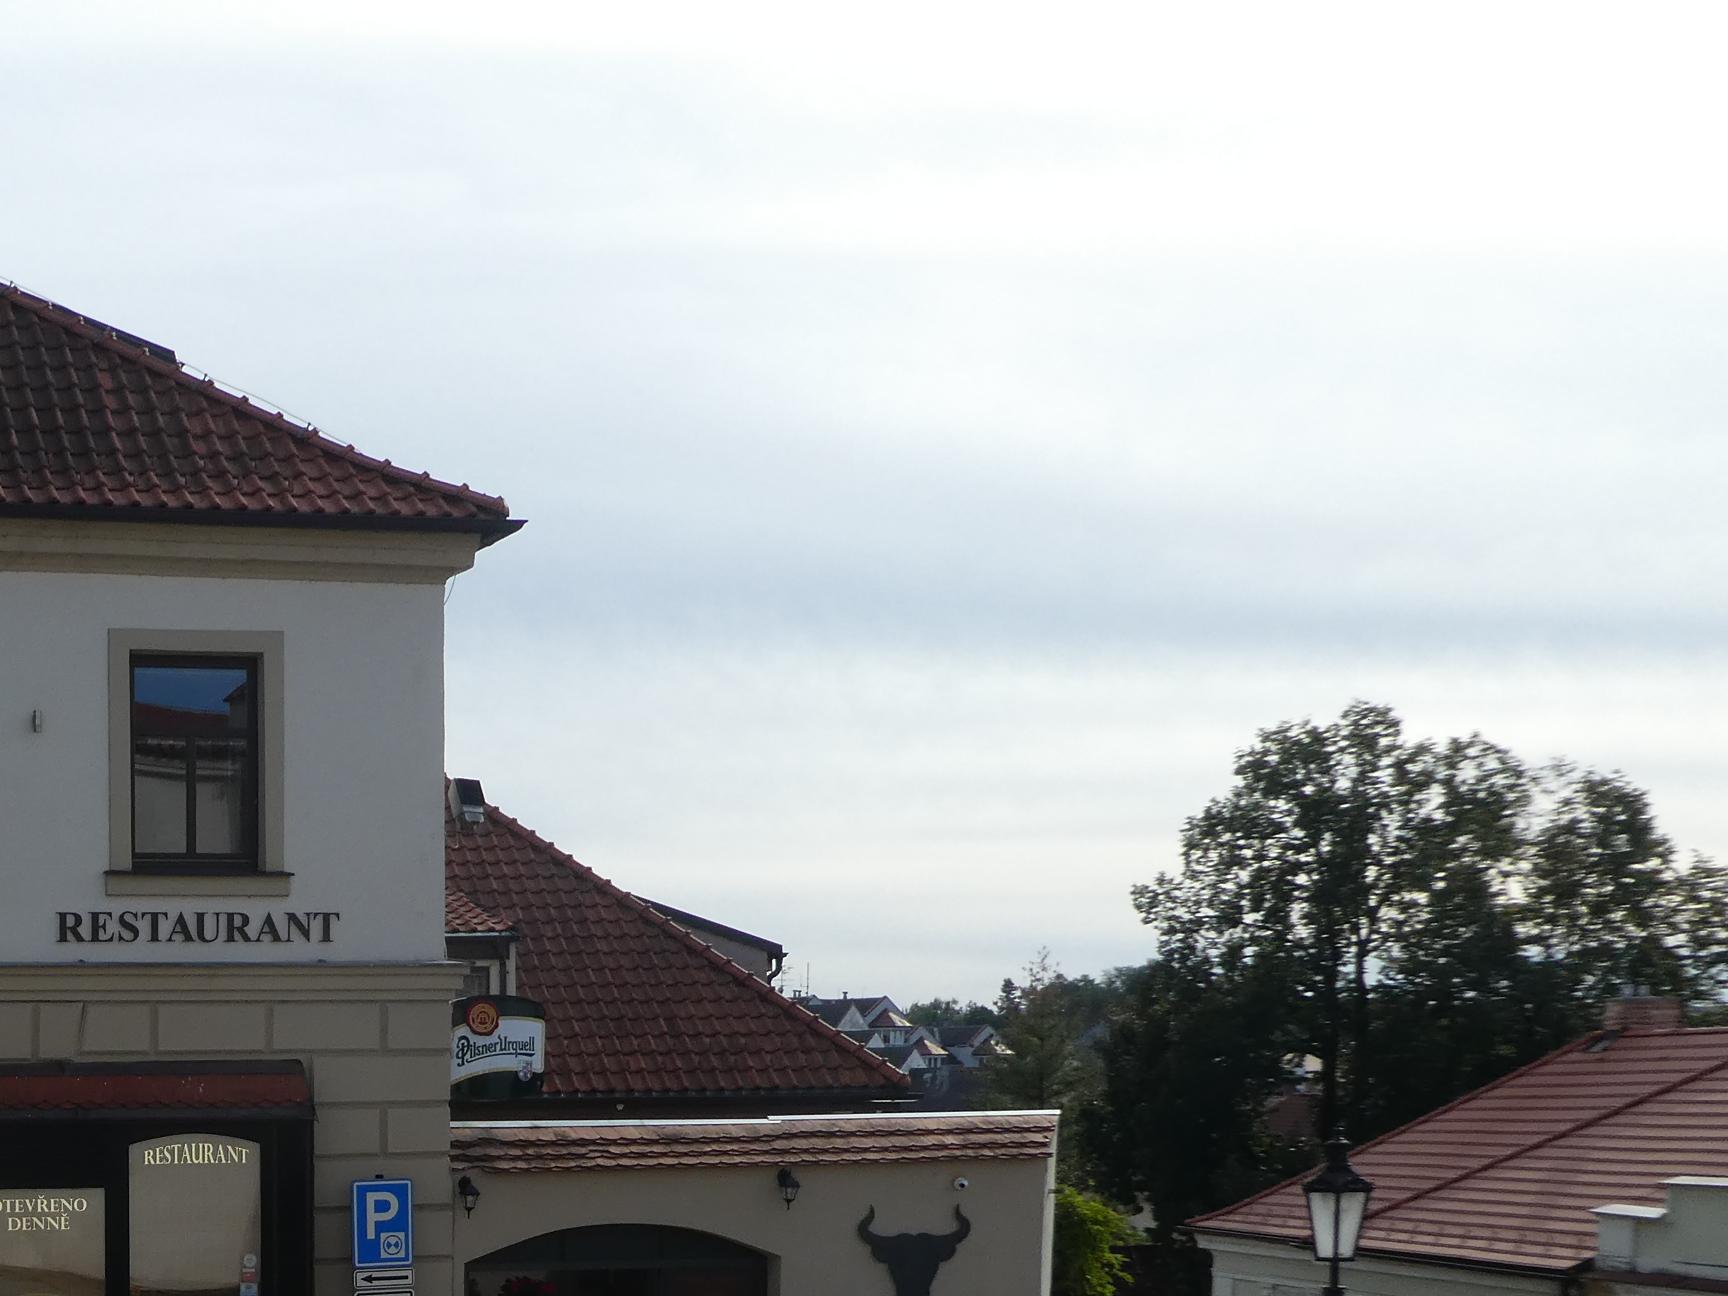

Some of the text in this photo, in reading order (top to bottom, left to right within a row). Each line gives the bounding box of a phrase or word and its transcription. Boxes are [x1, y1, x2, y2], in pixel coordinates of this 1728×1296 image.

[56, 910, 340, 943] RESTAURANT
[456, 1034, 535, 1067] Pilsner Urquell
[143, 1142, 250, 1166] RESTAURANT
[7, 1213, 71, 1231] DENNĚ
[366, 1191, 399, 1240] P
